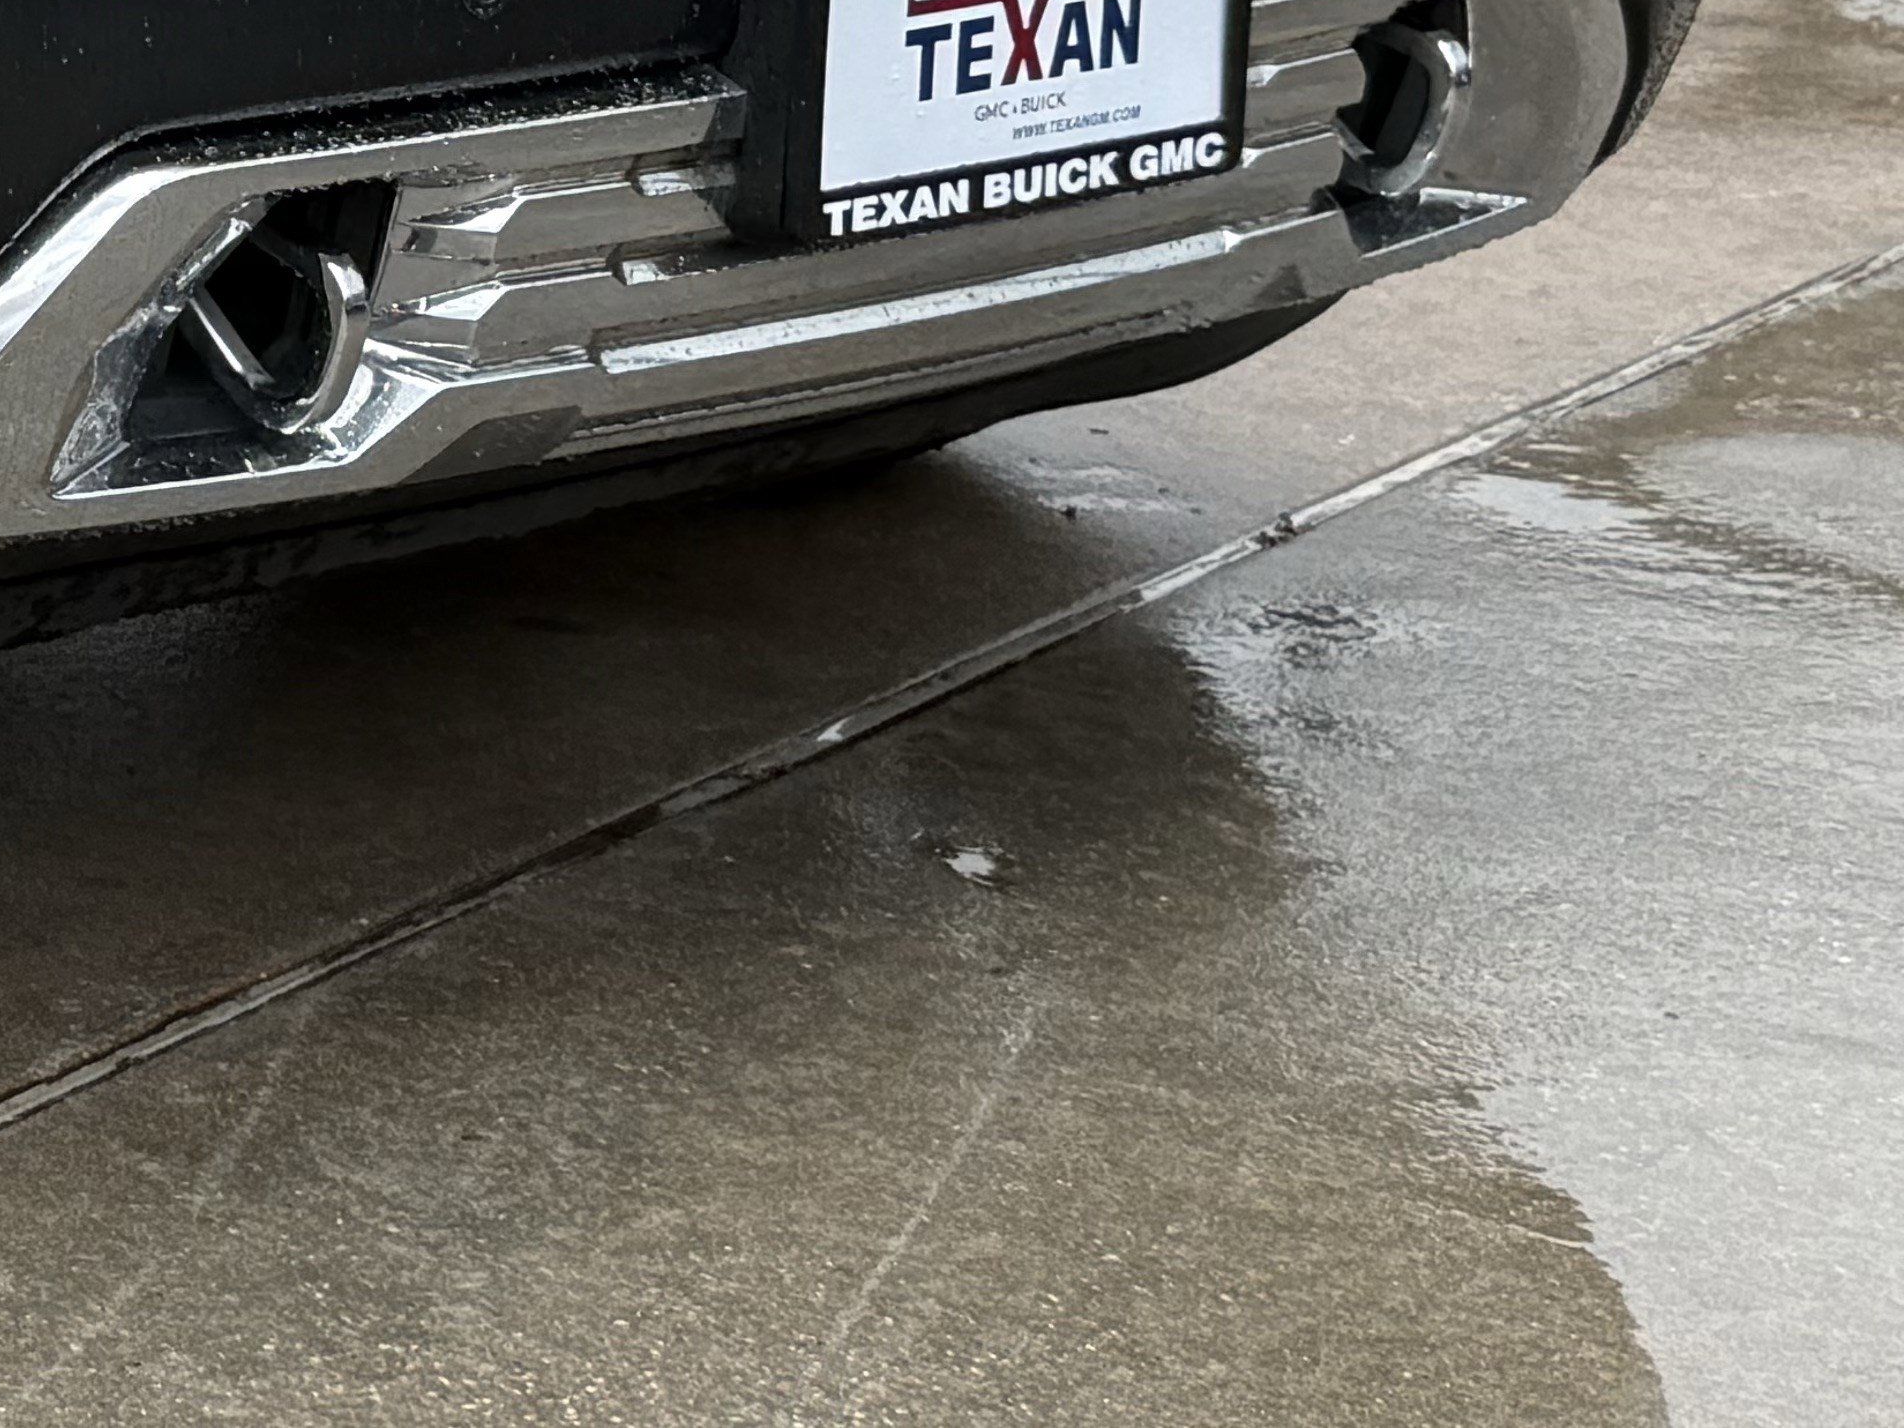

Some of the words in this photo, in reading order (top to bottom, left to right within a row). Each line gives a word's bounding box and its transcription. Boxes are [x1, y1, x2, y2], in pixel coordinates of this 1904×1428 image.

[975, 100, 1008, 123] GMC
[1021, 91, 1068, 115] BUICK
[823, 178, 970, 236] TEXAN
[983, 150, 1119, 209] BUICK
[1130, 131, 1226, 180] GMC
